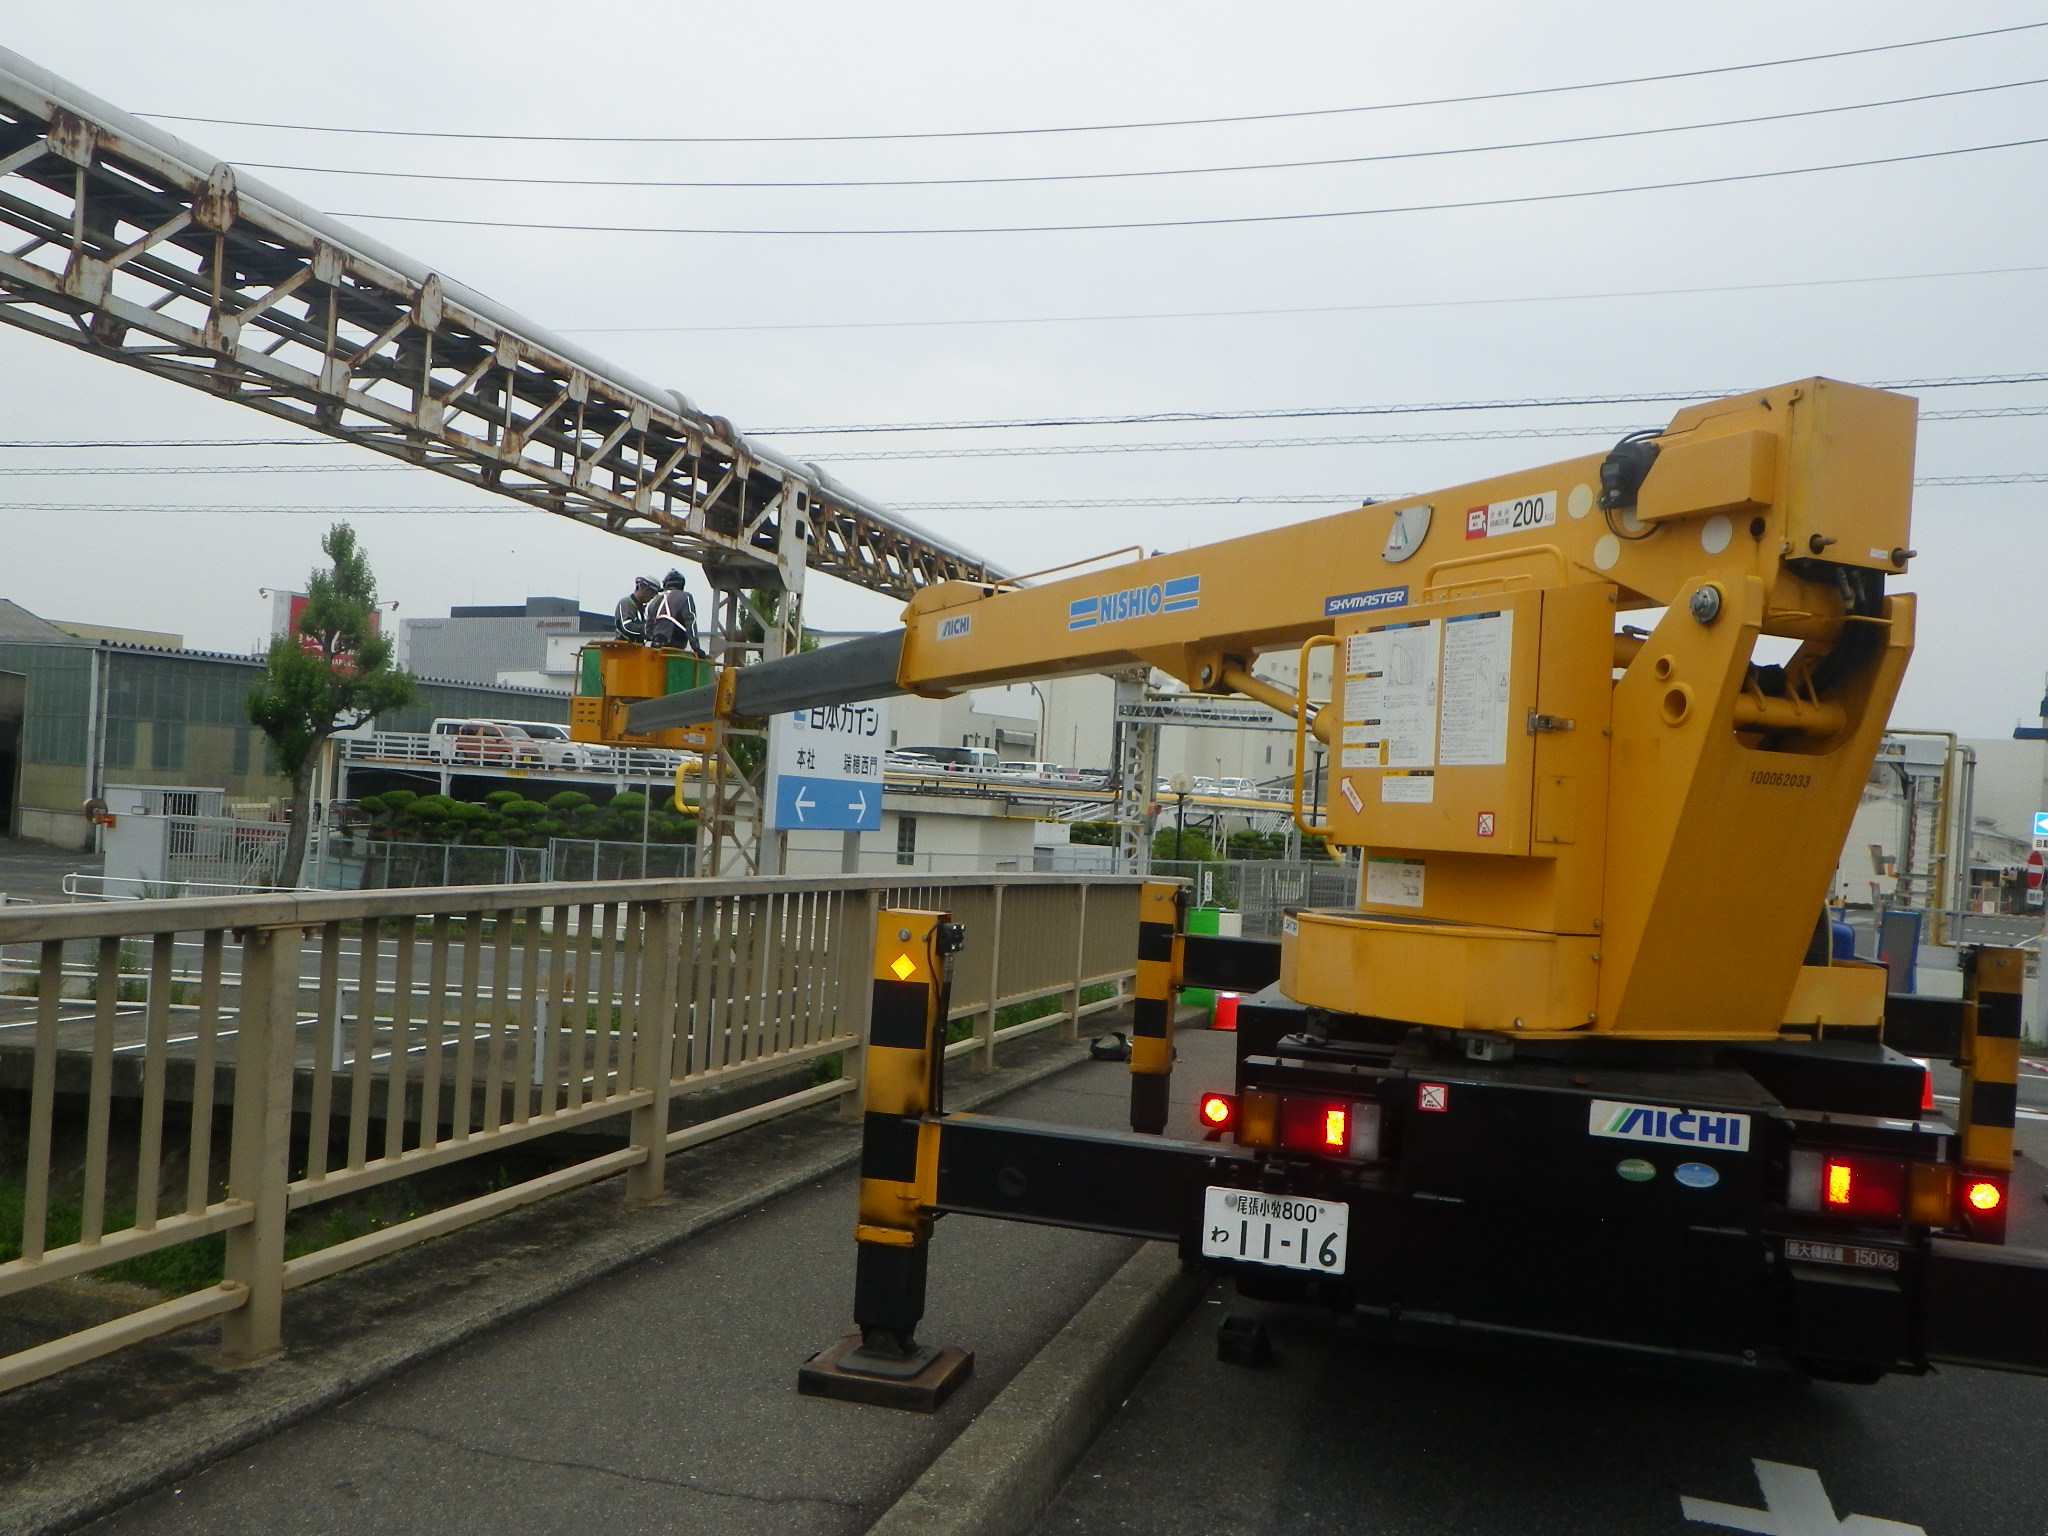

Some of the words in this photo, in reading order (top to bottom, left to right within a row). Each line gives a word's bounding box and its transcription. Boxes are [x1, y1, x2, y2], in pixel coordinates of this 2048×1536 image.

[1512, 497, 1544, 527] 200
[1100, 584, 1163, 624] NISHIO
[1328, 590, 1405, 612] SKYMASTER
[941, 615, 970, 637] AICHI
[811, 703, 879, 737] 日本ガイシ
[797, 747, 815, 770] 本社
[843, 752, 878, 776] 瑞穂西門
[1751, 771, 1811, 788] 100062033
[1618, 1108, 1741, 1146] AICHI
[1211, 1226, 1229, 1243] わ
[1239, 1220, 1338, 1267] 11-16
